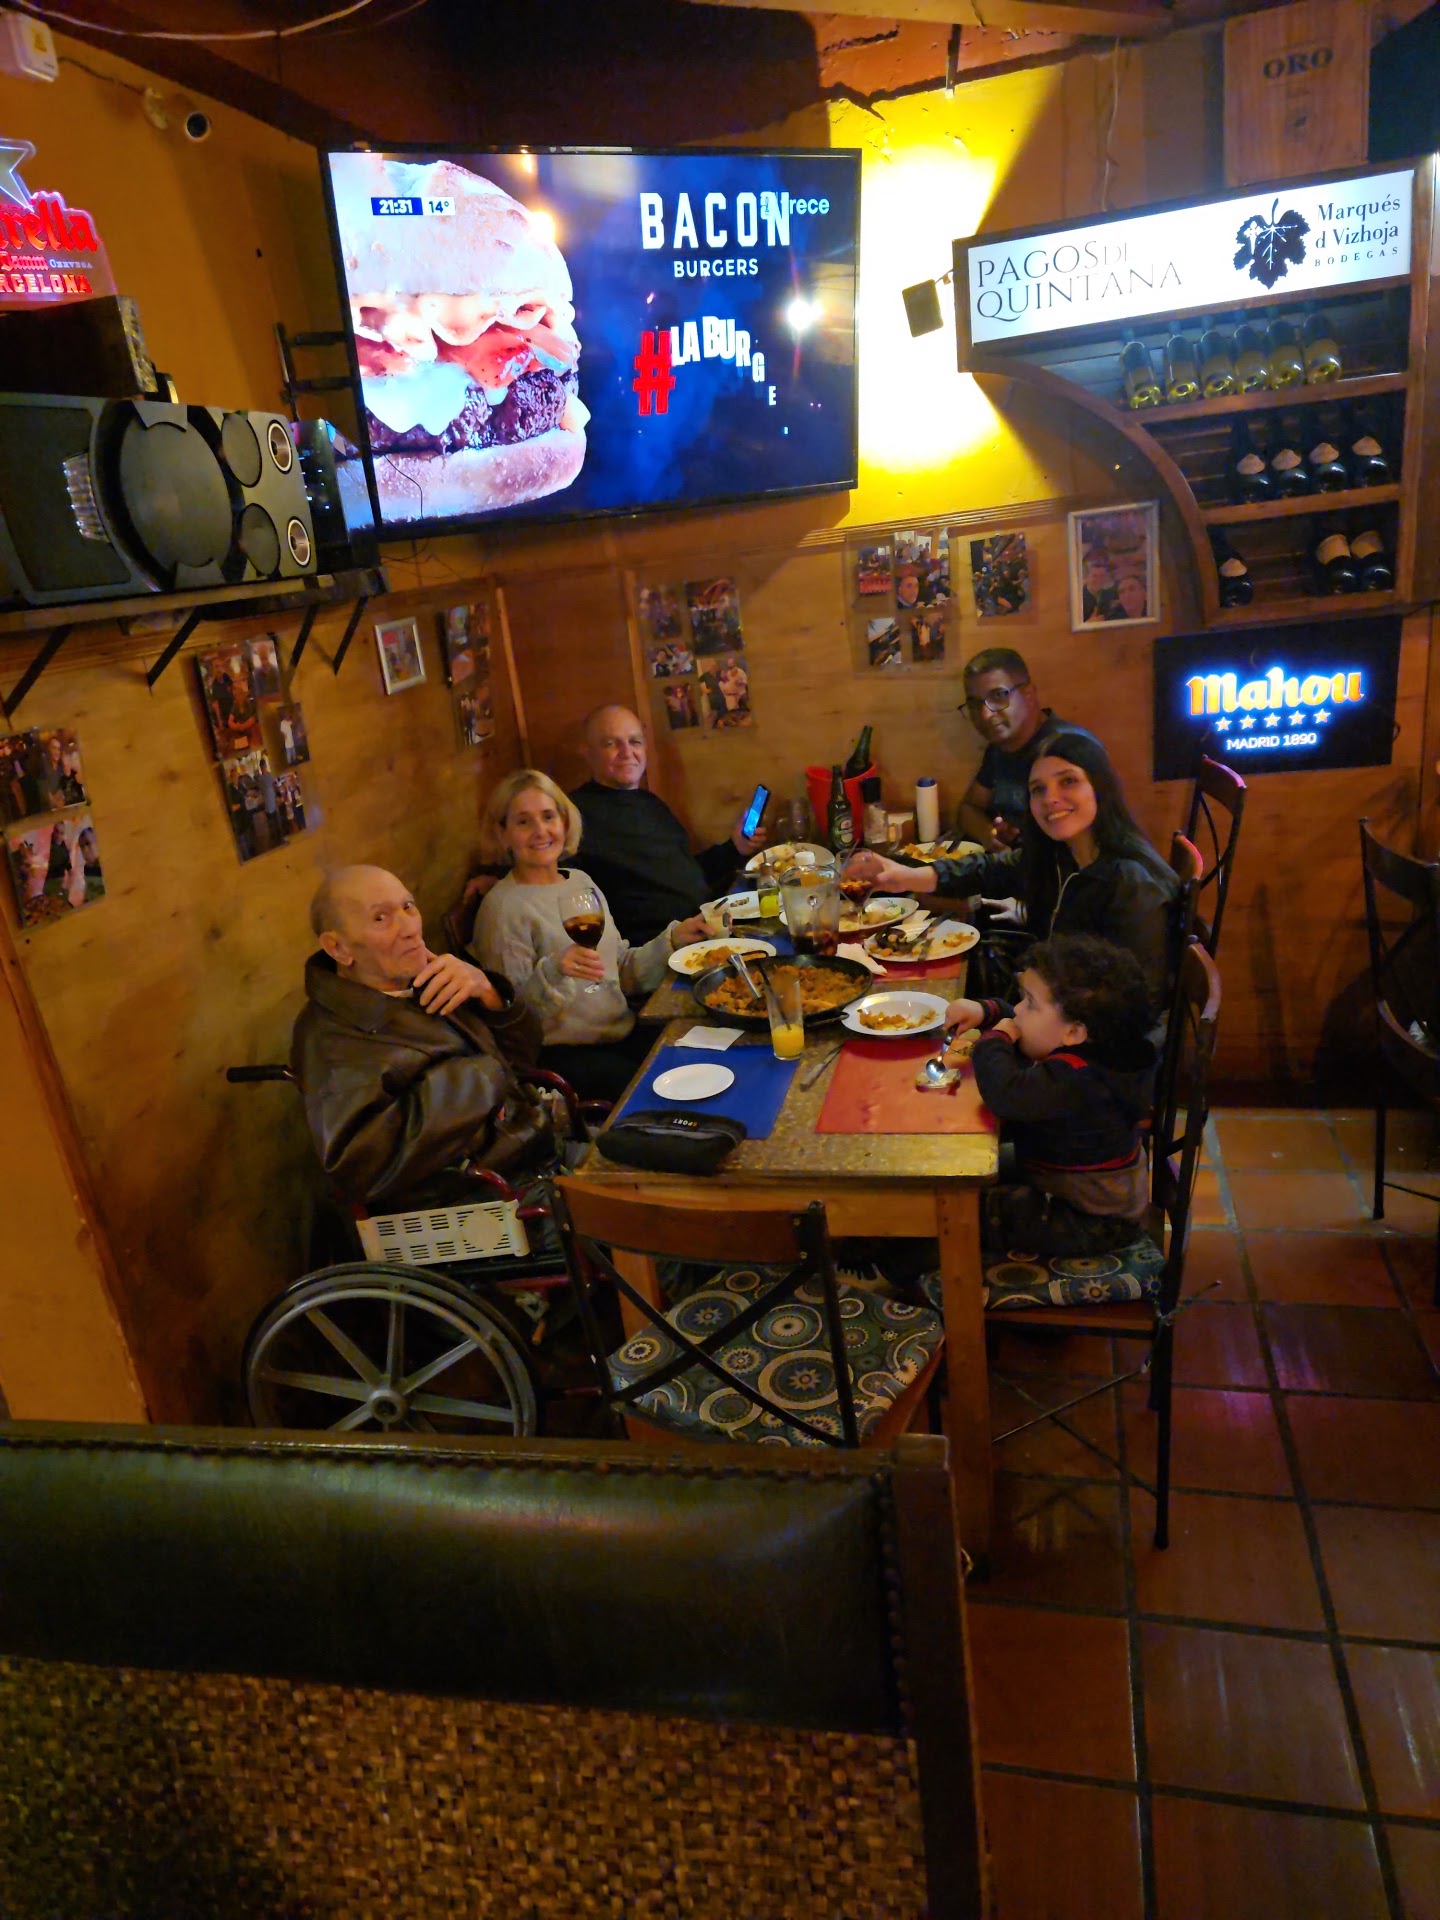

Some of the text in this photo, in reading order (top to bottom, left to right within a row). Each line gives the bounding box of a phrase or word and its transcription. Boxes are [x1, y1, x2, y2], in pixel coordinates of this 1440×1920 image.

[1262, 48, 1334, 79] ORO
[639, 191, 791, 250] BACON
[1317, 193, 1401, 222] Marqués
[1333, 221, 1399, 246] Vizhoja
[673, 258, 759, 278] BURGERS
[978, 240, 1099, 288] PAGOS
[1315, 246, 1398, 267] BODEGAS
[976, 261, 1183, 322] QUINTANA
[1227, 732, 1317, 750] MADRID 1890
